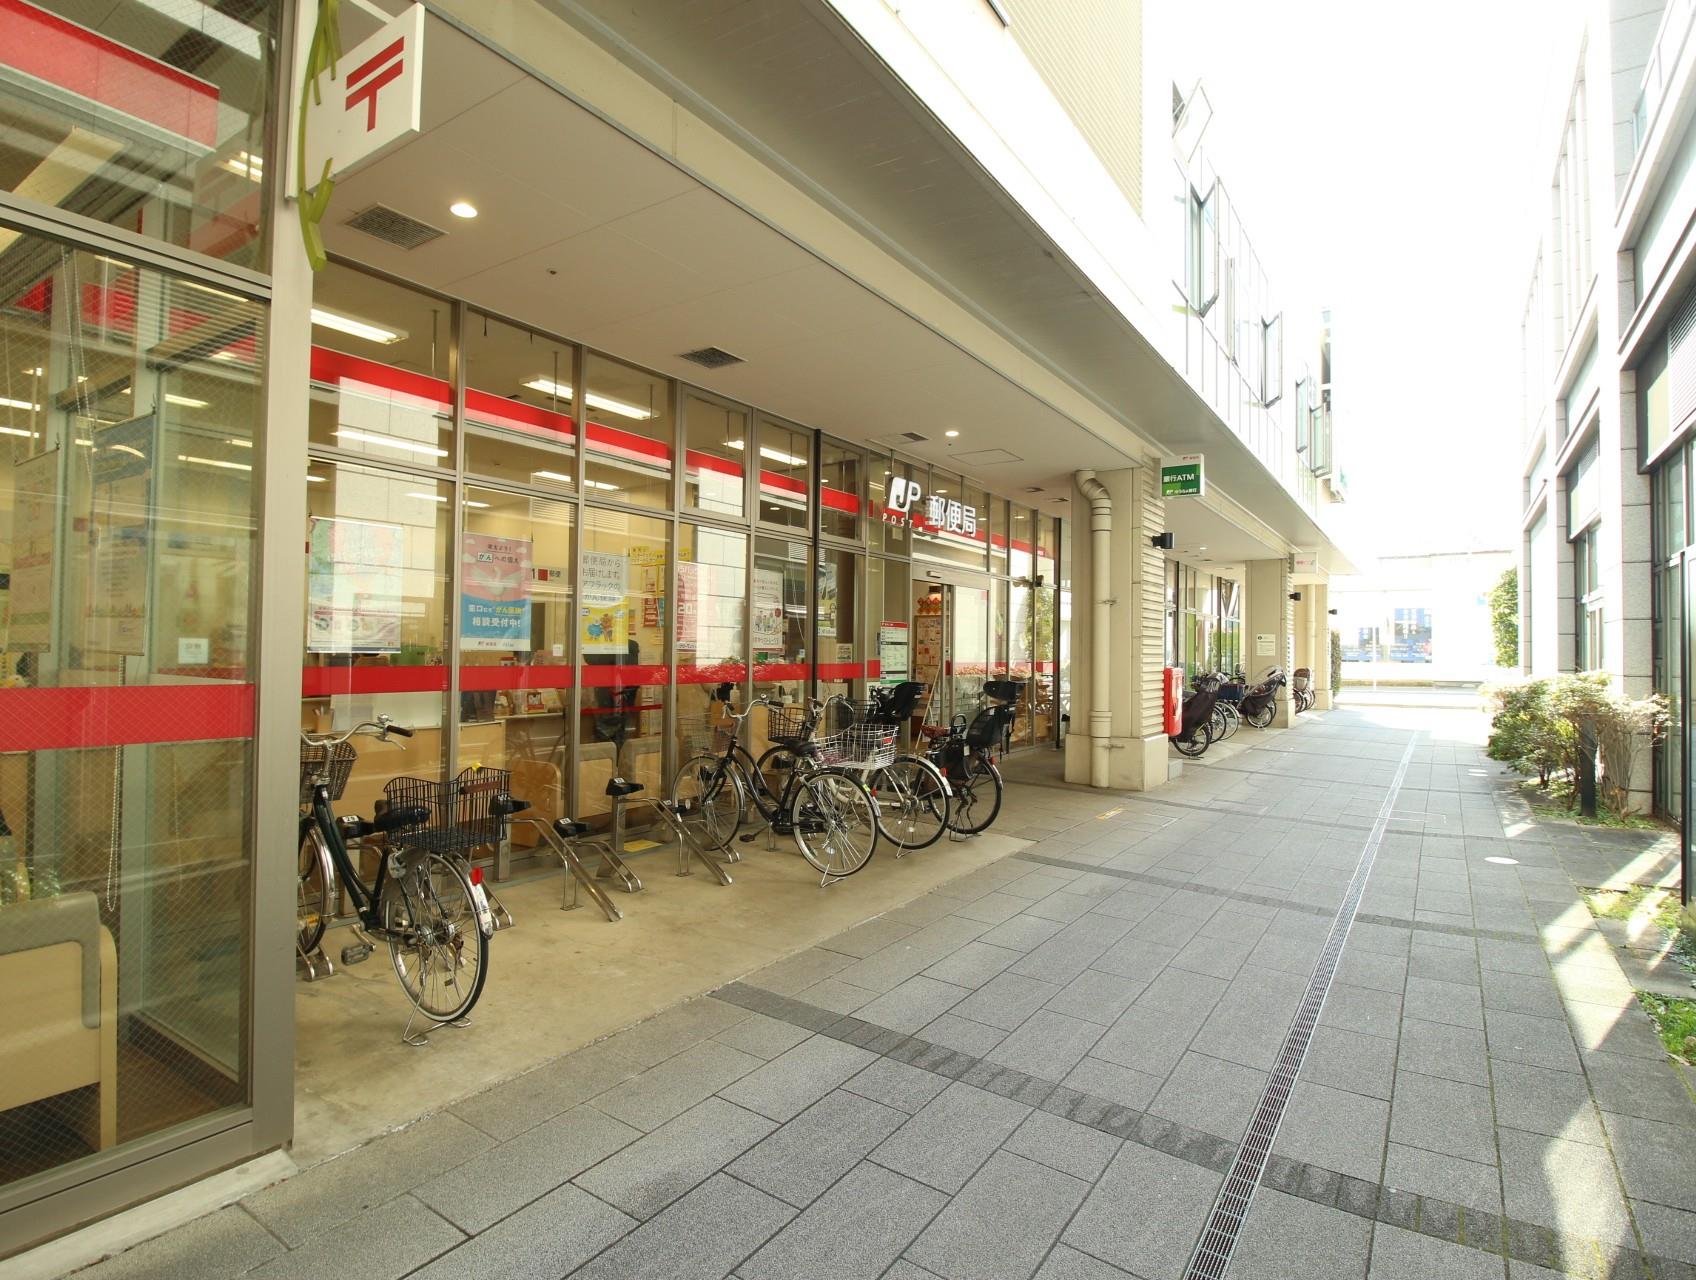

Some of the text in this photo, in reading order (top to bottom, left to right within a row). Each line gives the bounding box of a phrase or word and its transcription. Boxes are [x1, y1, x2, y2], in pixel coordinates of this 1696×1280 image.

[888, 477, 921, 512] JP
[882, 513, 914, 528] POST
[926, 496, 976, 537] 郵便局
